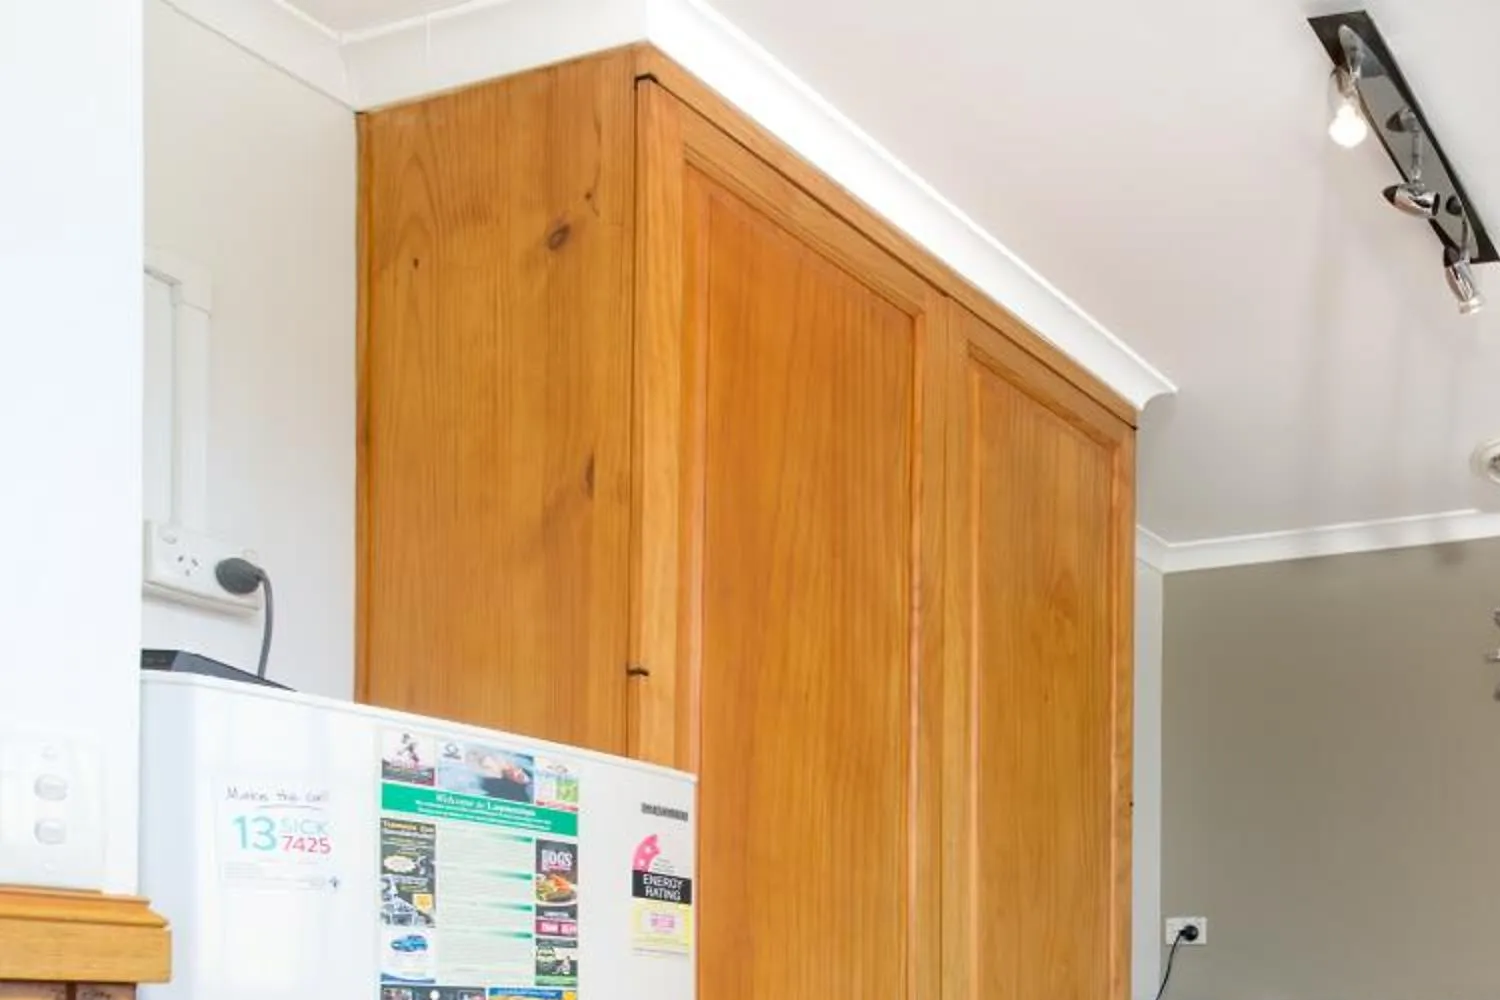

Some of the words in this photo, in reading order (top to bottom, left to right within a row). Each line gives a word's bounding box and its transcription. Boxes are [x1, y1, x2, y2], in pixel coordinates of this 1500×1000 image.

[233, 815, 277, 851] 13
[280, 818, 330, 836] SICK
[282, 835, 332, 855] 7425
[643, 873, 684, 890] ENERGY
[645, 887, 682, 901] RATING
